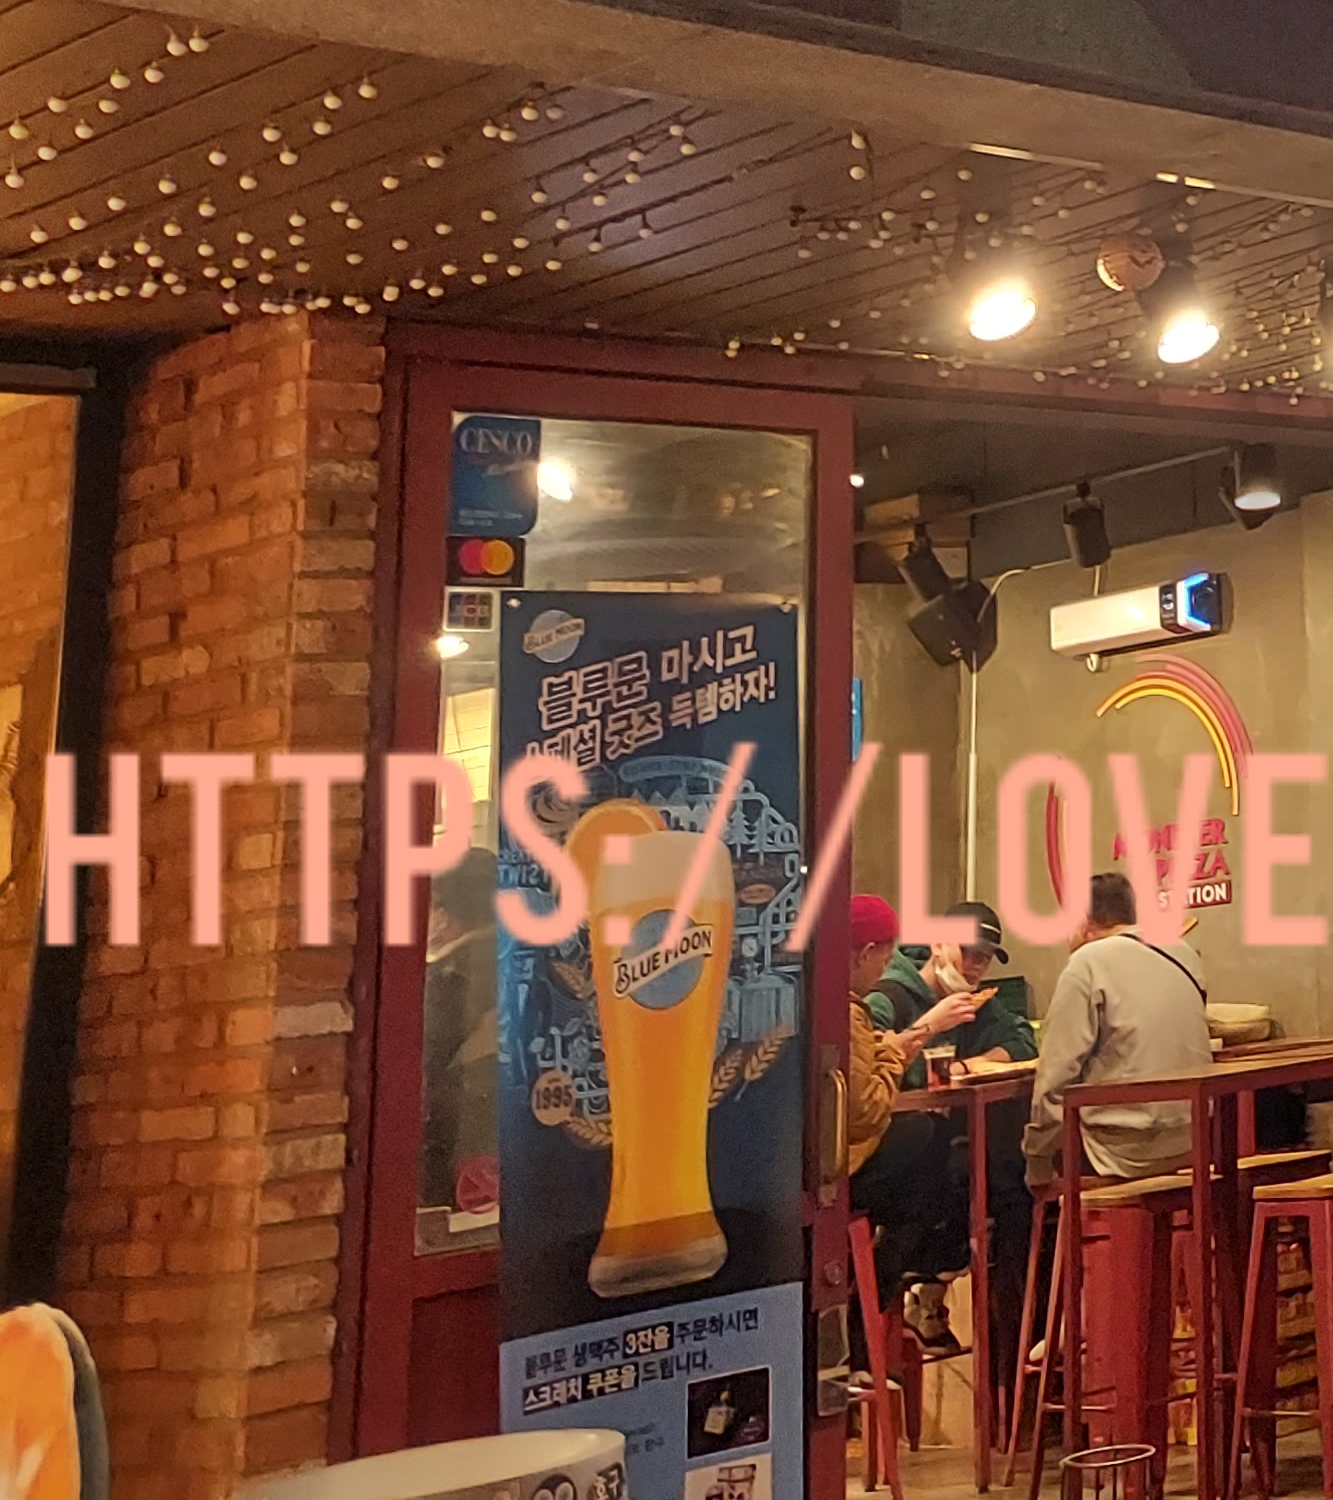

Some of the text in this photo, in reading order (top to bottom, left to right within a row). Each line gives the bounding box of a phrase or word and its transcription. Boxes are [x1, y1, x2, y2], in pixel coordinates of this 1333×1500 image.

[538, 624, 759, 732] 블루문 마시고
[668, 661, 777, 729] 득템하자!
[615, 950, 661, 995] BLUE
[534, 1085, 574, 1111] 1995
[624, 1324, 672, 1355] 3잔을
[675, 1307, 760, 1343] 주문하시면
[523, 1349, 714, 1412] 스크래치 쿠폰을 드립니다.
